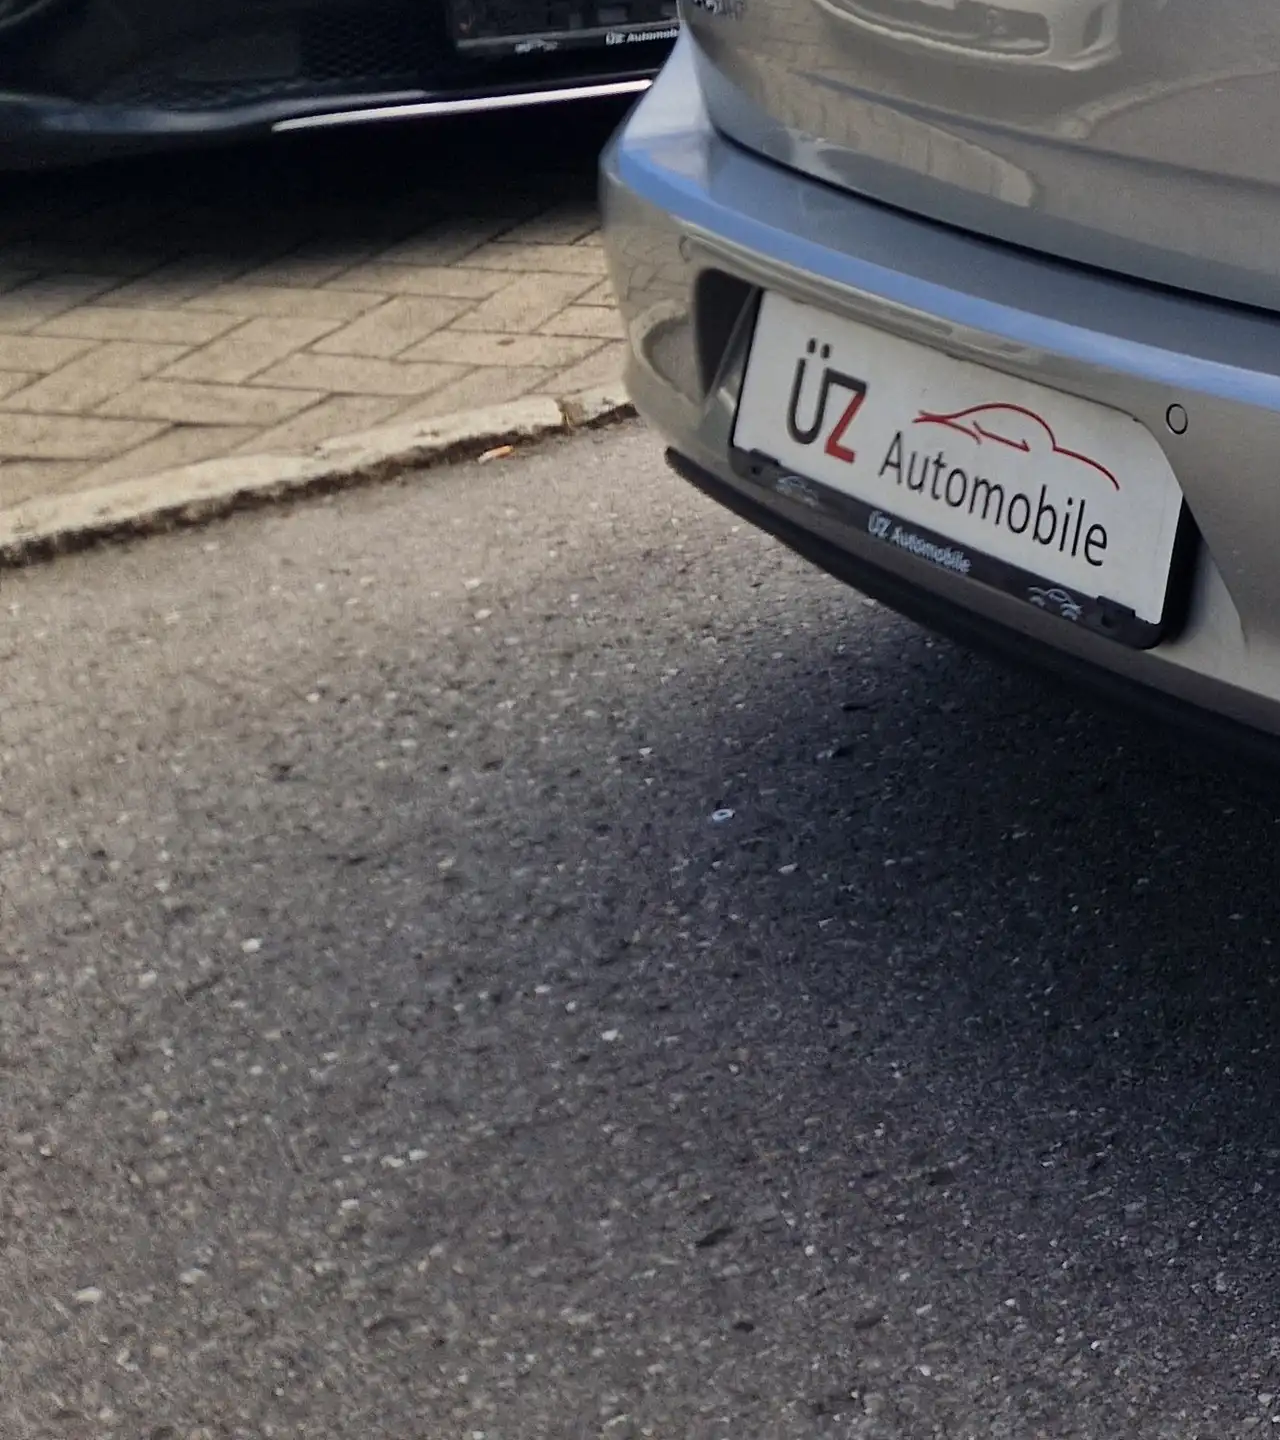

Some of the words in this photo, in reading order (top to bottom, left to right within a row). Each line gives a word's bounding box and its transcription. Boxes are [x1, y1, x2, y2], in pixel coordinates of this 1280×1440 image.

[786, 338, 868, 465] ÜZ
[878, 430, 1108, 567] Automobile
[891, 525, 971, 574] Automobile
